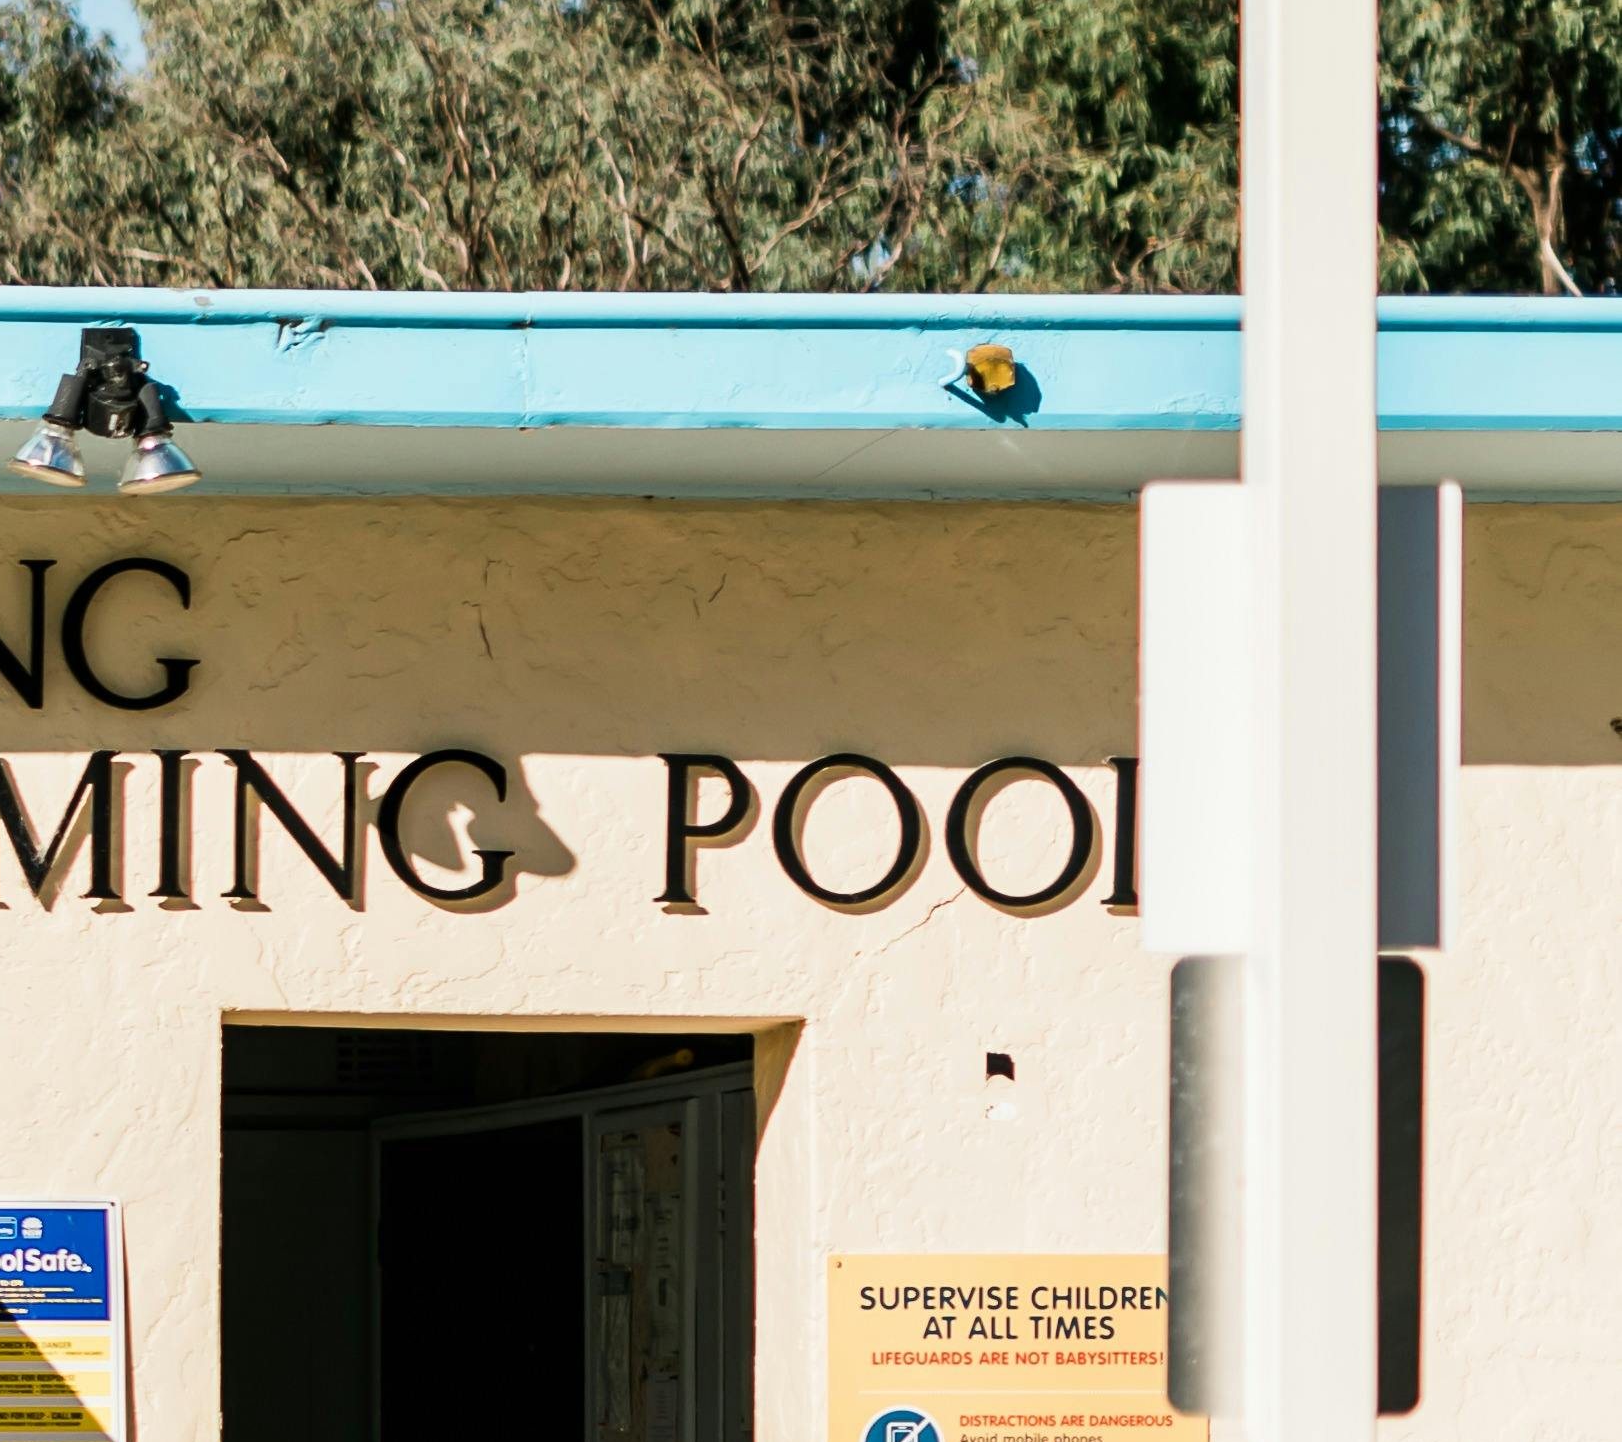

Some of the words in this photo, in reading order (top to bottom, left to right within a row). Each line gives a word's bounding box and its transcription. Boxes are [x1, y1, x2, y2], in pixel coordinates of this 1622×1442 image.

[860, 1286, 1020, 1311] SUPERVISE
[923, 1316, 957, 1340] AT
[968, 1316, 1018, 1340] ALL
[1029, 1316, 1115, 1340] TIMES
[872, 1351, 973, 1367] LIFEGUARDS
[979, 1351, 1010, 1367] ARE
[1015, 1351, 1051, 1367] NOT
[1055, 1351, 1165, 1367] BABYSITTERS!
[960, 1415, 1057, 1428] DISTRACTIONS
[1060, 1415, 1085, 1428] ARE
[1089, 1415, 1174, 1428] DANGEROUS
